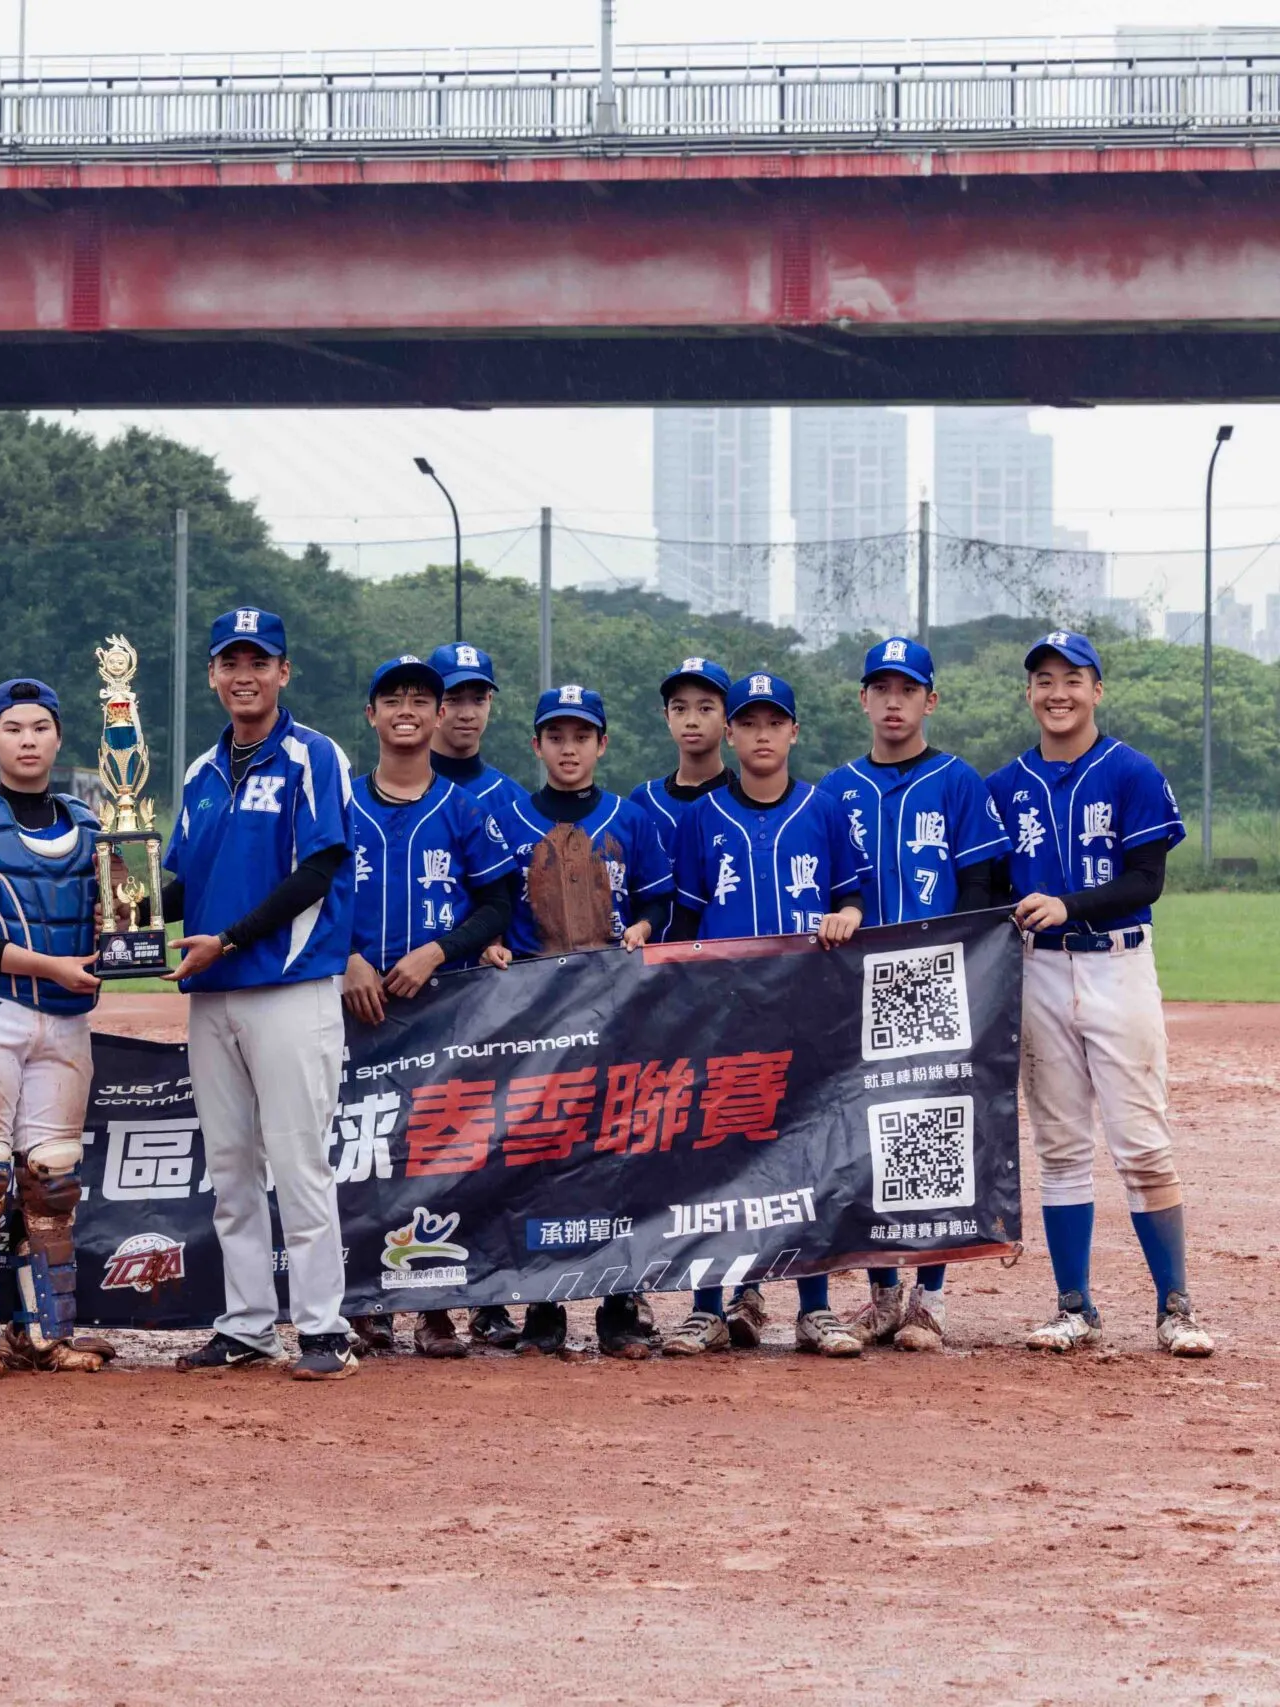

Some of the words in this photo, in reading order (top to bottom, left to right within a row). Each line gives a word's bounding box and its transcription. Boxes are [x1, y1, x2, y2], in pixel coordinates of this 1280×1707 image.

[234, 610, 260, 633] H
[455, 645, 480, 667] H
[882, 640, 907, 662] H
[558, 685, 582, 705] H
[749, 674, 773, 696] H
[1081, 855, 1114, 889] 19
[914, 866, 939, 905] 7
[422, 899, 455, 931] 14
[442, 1030, 600, 1060] Tournament
[863, 1062, 974, 1089] 就是棒粉絲專頁
[94, 1091, 194, 1107] Commu
[98, 1081, 170, 1095] JUST
[663, 1200, 738, 1239] JUST
[741, 1187, 817, 1231] BEST
[540, 1216, 634, 1245] 承辦單位
[870, 1219, 978, 1239] 就是棒賽事網站
